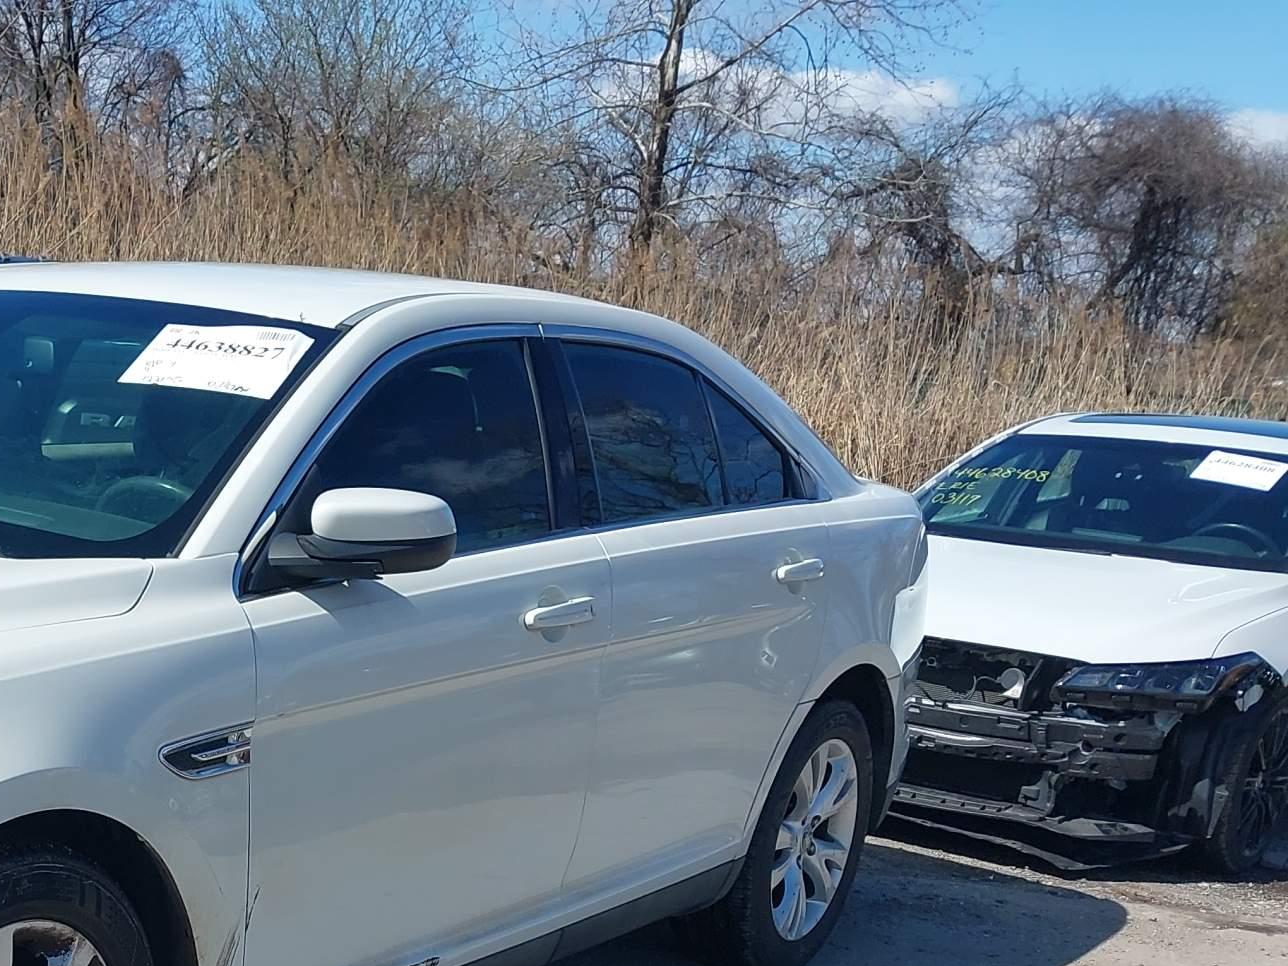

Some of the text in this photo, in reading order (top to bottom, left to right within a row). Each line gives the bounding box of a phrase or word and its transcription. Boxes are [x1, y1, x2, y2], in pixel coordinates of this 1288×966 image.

[166, 337, 287, 360] 44638827
[954, 466, 1050, 483] 44628408
[930, 492, 982, 506] 03/17
